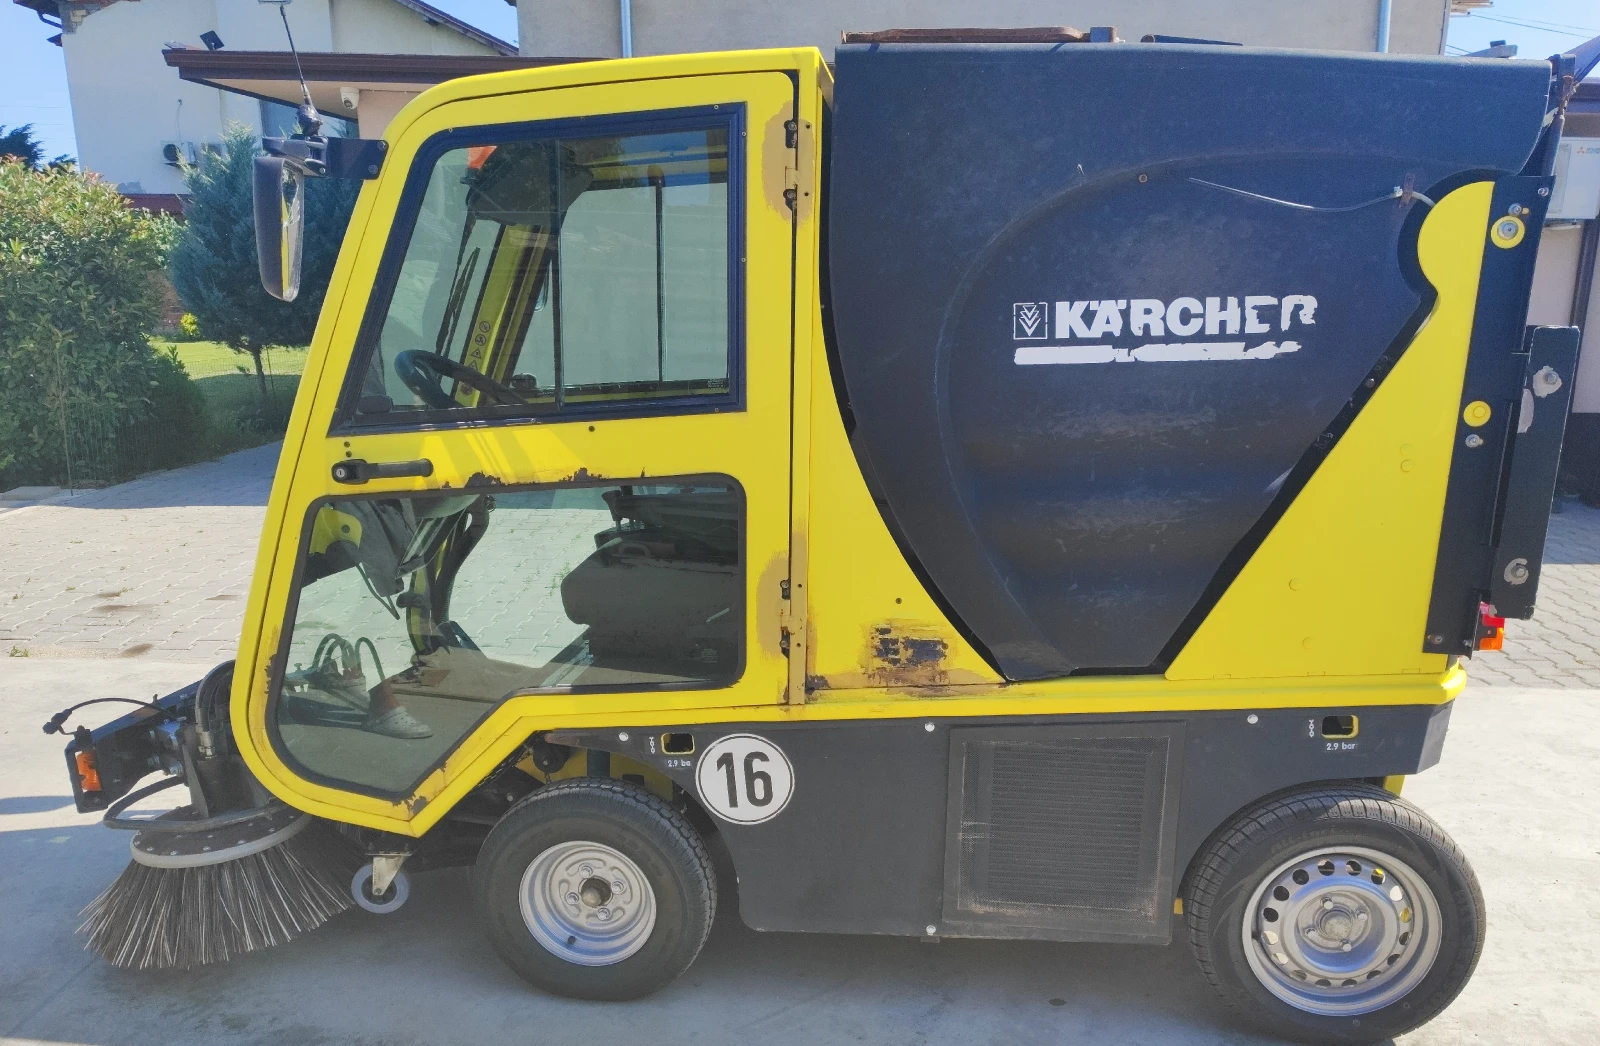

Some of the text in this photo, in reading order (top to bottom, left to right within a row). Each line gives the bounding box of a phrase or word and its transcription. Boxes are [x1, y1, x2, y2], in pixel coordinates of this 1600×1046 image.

[1326, 741, 1356, 751] 2.9 bar
[667, 759, 678, 768] 2.9
[716, 751, 774, 808] 16
